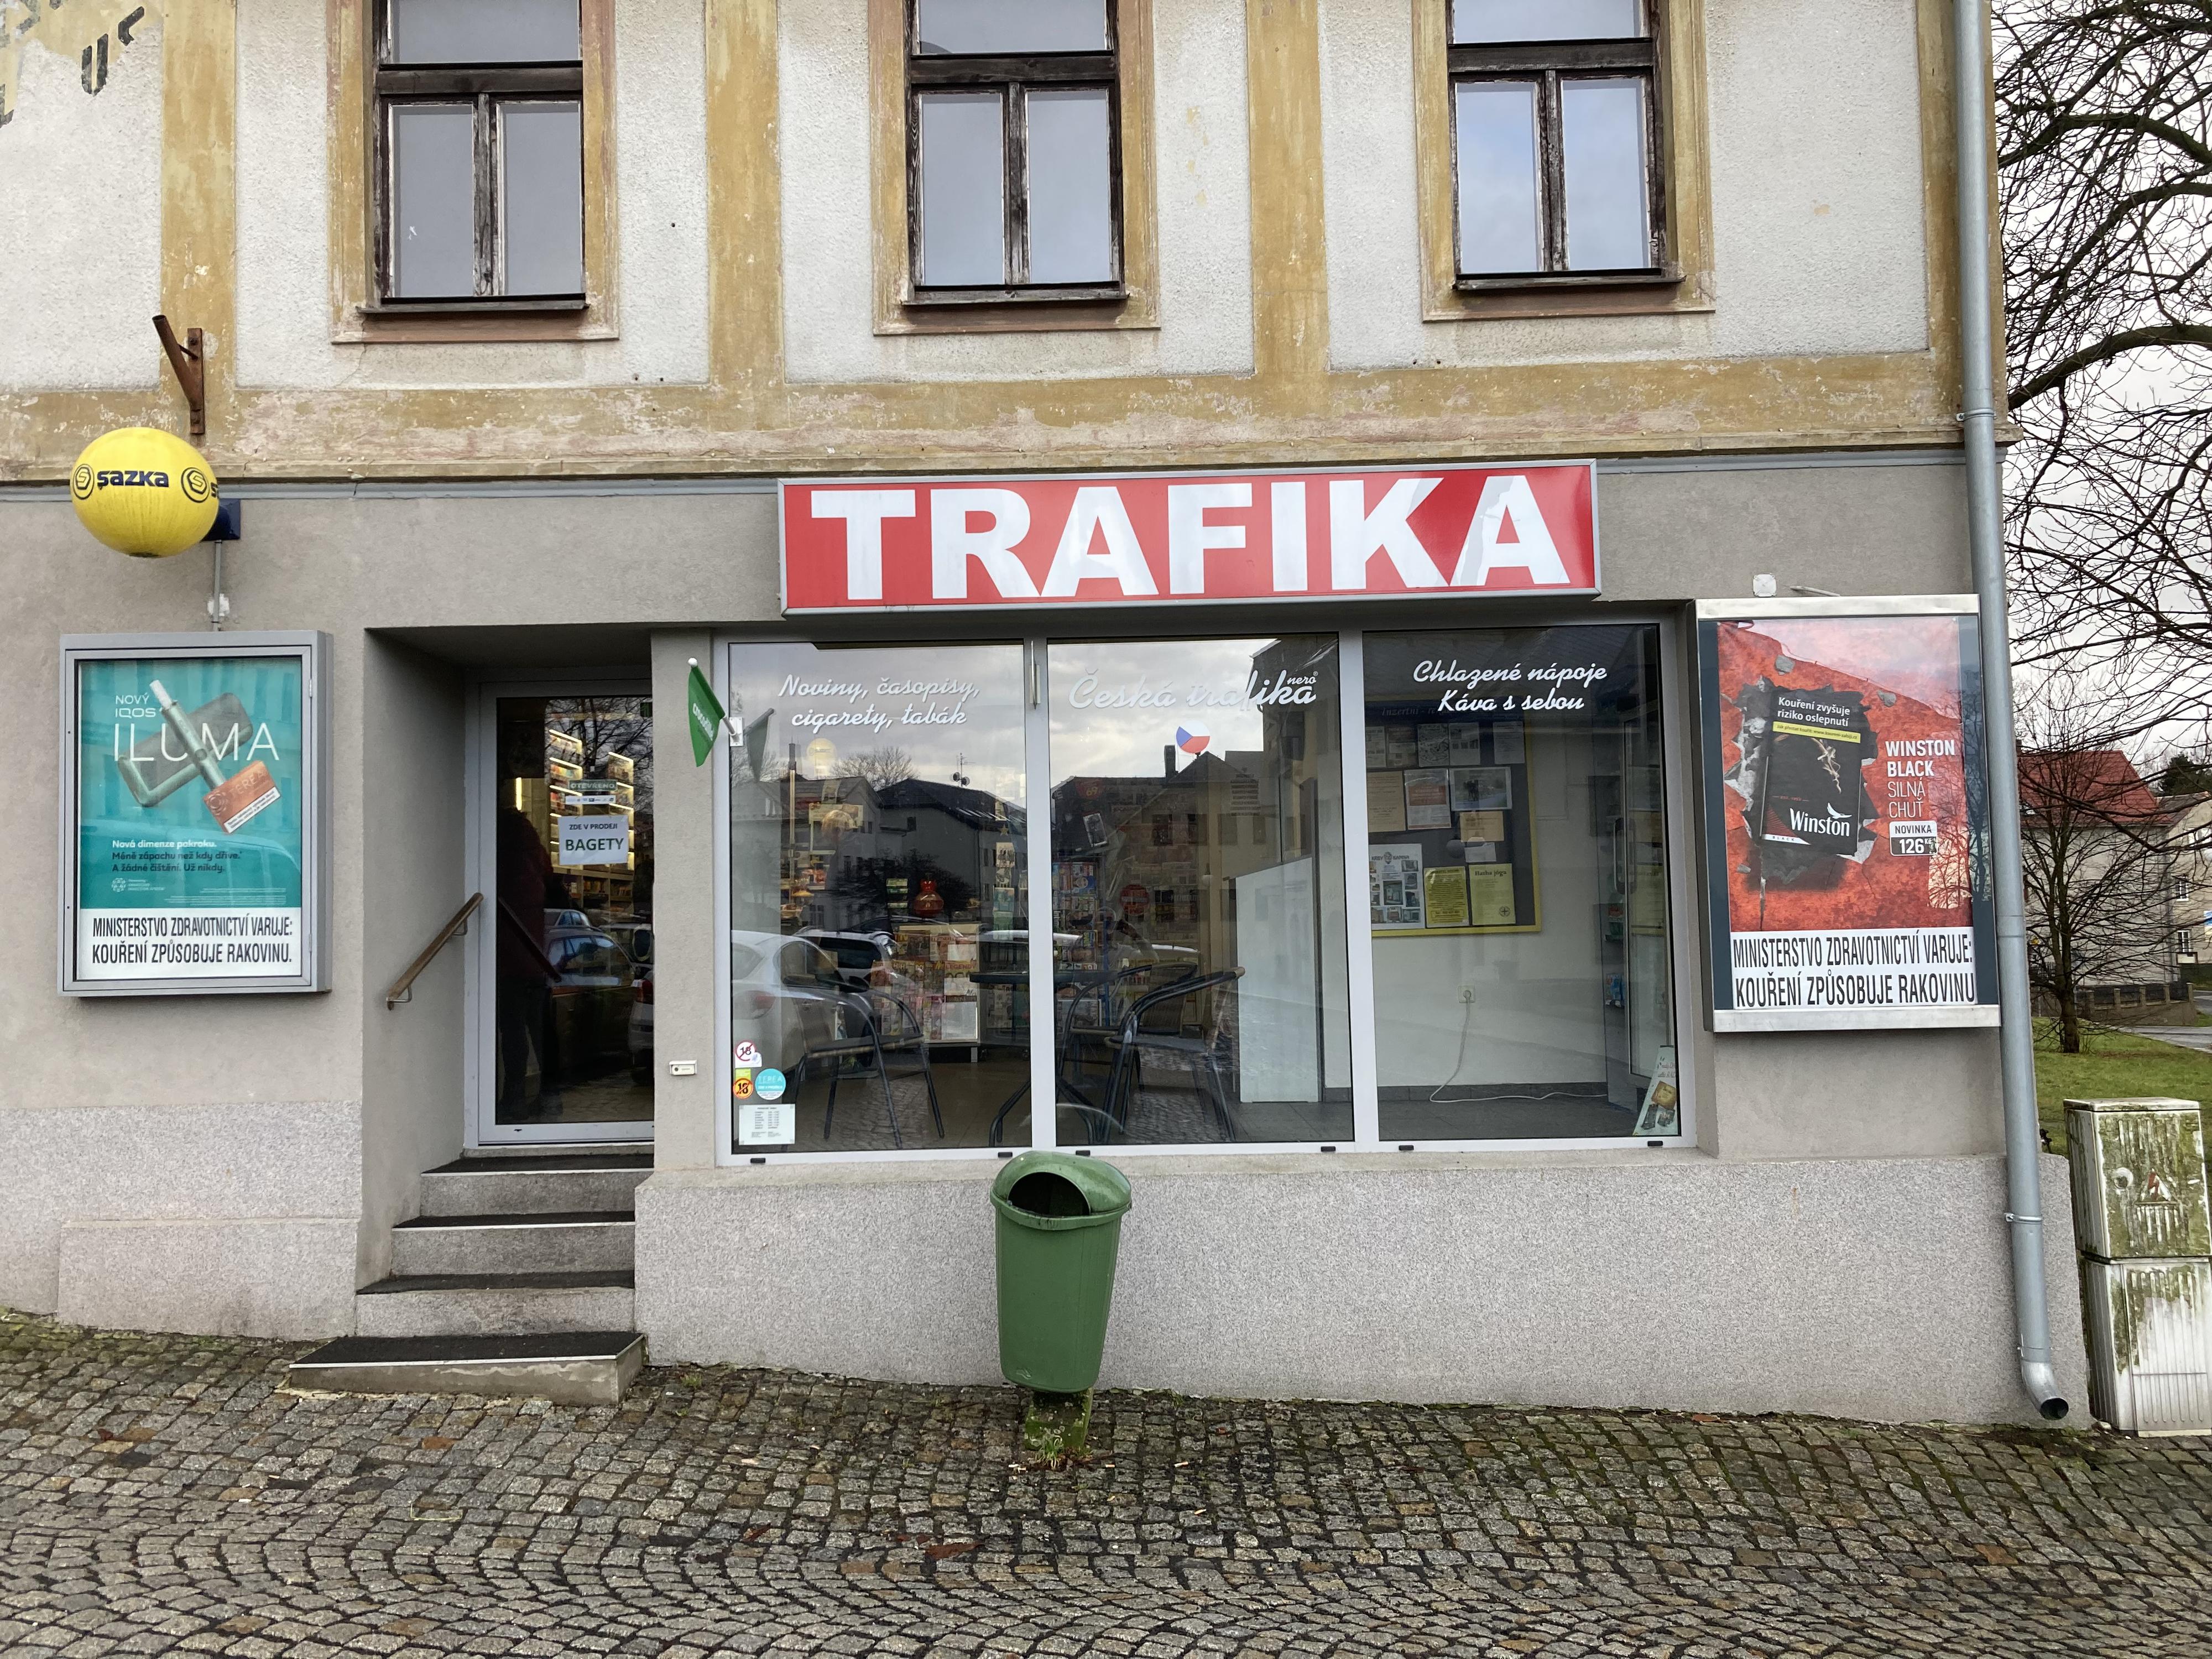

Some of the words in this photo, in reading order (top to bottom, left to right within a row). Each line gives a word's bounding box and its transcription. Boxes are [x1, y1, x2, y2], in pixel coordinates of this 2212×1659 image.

[810, 474, 1571, 601] TRAFIKA
[1413, 659, 1522, 689] Chlazené
[1527, 663, 1608, 688] nápoje
[116, 692, 149, 705] NOVÝ
[778, 674, 869, 703] Noviny,
[877, 677, 981, 702] časopisy,
[1068, 667, 1177, 709] Česká
[1186, 670, 1317, 711] trafika
[1437, 690, 1498, 712] Káva
[1503, 693, 1516, 710] s
[1522, 687, 1585, 710] sebou
[1778, 697, 1815, 710] Kouření
[1817, 704, 1850, 717] zvyšuje
[115, 708, 156, 718] IQOS
[791, 703, 893, 734] cigarety,
[901, 702, 967, 724] tabák
[1777, 709, 1803, 721] riziko
[1806, 713, 1849, 727] oslepnutí
[1885, 739, 1955, 757] WINSTON
[1887, 760, 1934, 777] BLACK
[1888, 777, 1926, 797] SILNÁ
[1889, 797, 1924, 818] CHUŤ
[1790, 808, 1850, 837] Winston
[1895, 825, 1932, 834] NOVINKA
[112, 839, 136, 848] Nová
[138, 839, 174, 848] dimenze
[176, 839, 217, 849] pakroku.
[566, 838, 624, 851] BAGETY
[1899, 838, 1924, 854] 126
[139, 852, 175, 862] zápachu
[196, 851, 212, 862] kdy
[112, 864, 119, 872] A
[121, 864, 148, 872] žádné
[184, 863, 195, 872] Už
[197, 863, 225, 873] nikdy.
[93, 916, 167, 937] MINISTERSTVO
[171, 913, 249, 936] ZDRAVOTNICTVÍ
[252, 916, 293, 936] VARUJE:
[92, 940, 148, 964] KOUŘENÍ
[151, 939, 223, 963] ZPŮSOBUJE
[227, 942, 292, 963] RAKOVINU.
[1733, 936, 1822, 968] MINISTERSTVO
[1826, 930, 1920, 966] ZDRAVOTNICTVÍ
[1923, 933, 1973, 963] VARUJE:
[1735, 970, 1802, 1008] KOUŘENÍ
[1807, 969, 1893, 1006] ZPŮSOBUJE
[1898, 972, 1975, 1004] RAKOVINU
